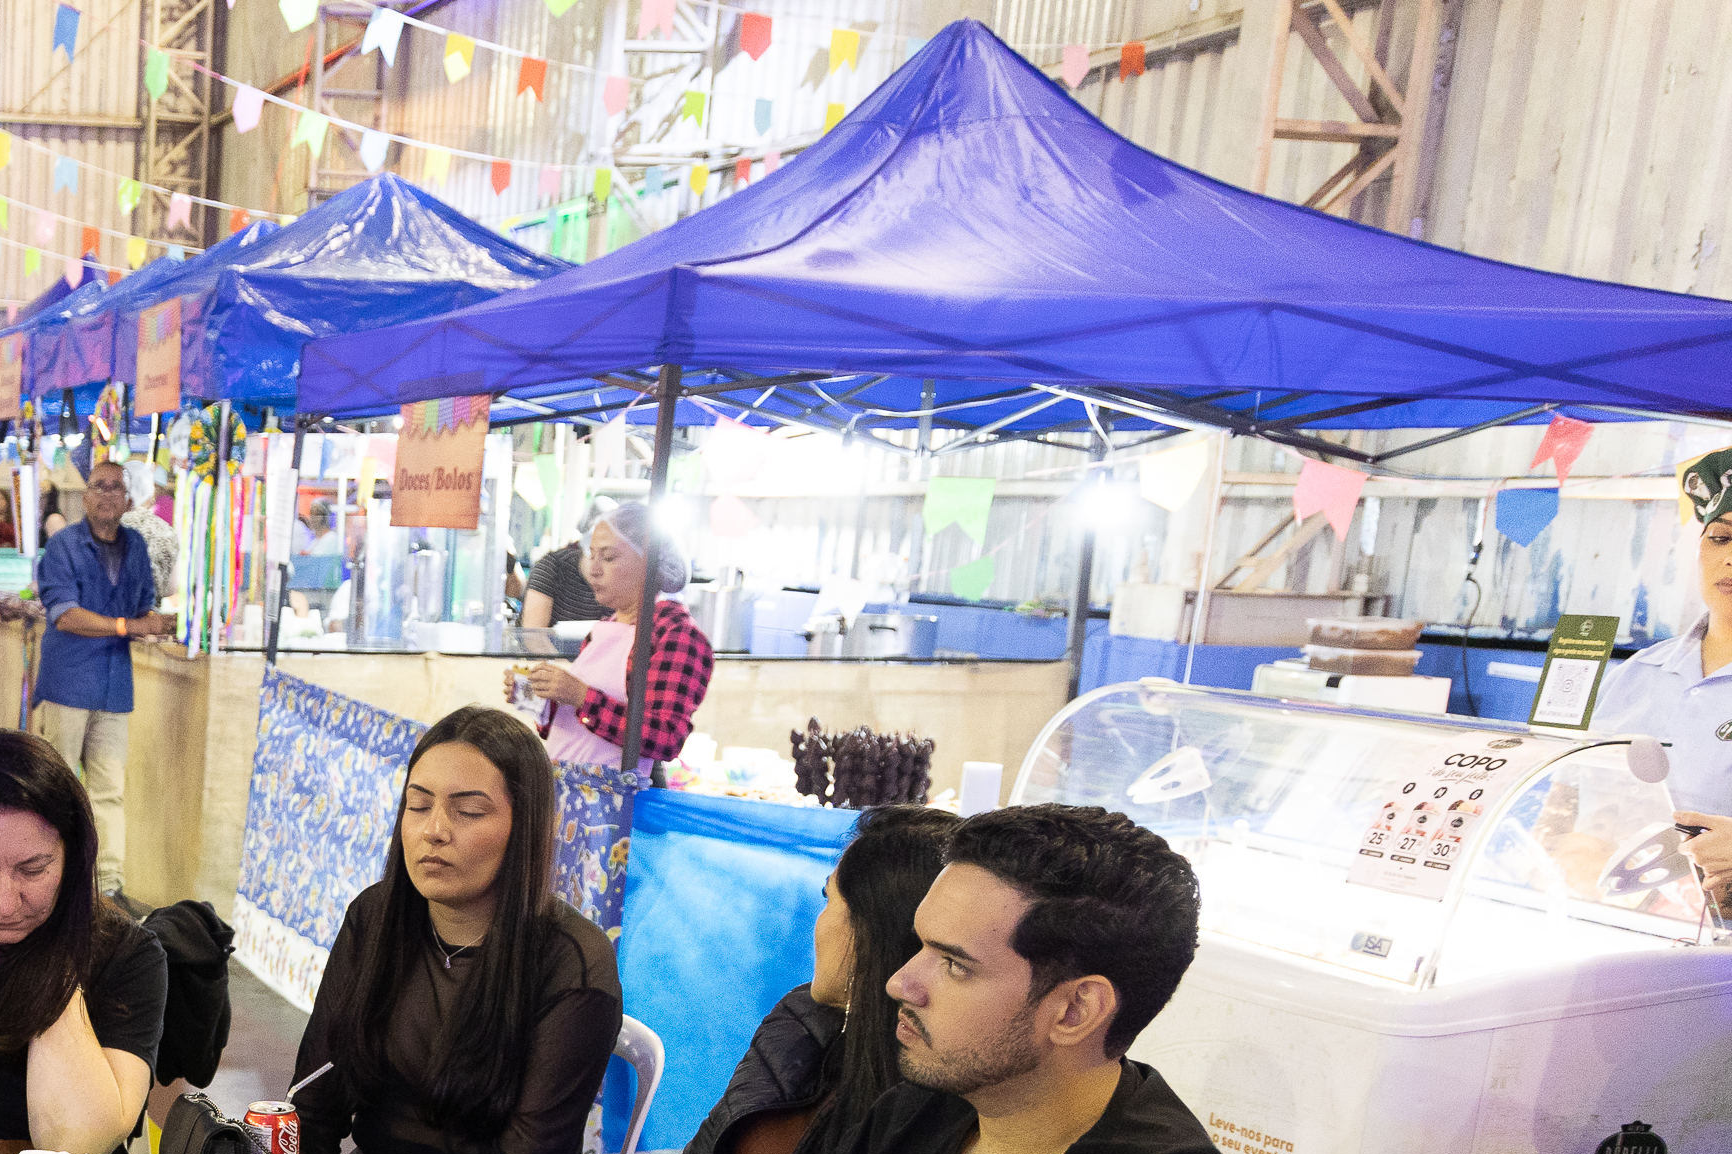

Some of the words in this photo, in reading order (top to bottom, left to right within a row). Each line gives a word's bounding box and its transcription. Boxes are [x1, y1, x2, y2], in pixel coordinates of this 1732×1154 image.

[398, 466, 473, 496] Doces/Bolos
[1444, 753, 1508, 771] COPO
[1369, 832, 1385, 845] 25
[1400, 837, 1417, 851] 27
[1433, 843, 1450, 857] 30
[1209, 1112, 1262, 1143] Leve-nos
[1263, 1134, 1294, 1153] para
[1212, 1133, 1220, 1144] o
[1221, 1136, 1242, 1151] seu
